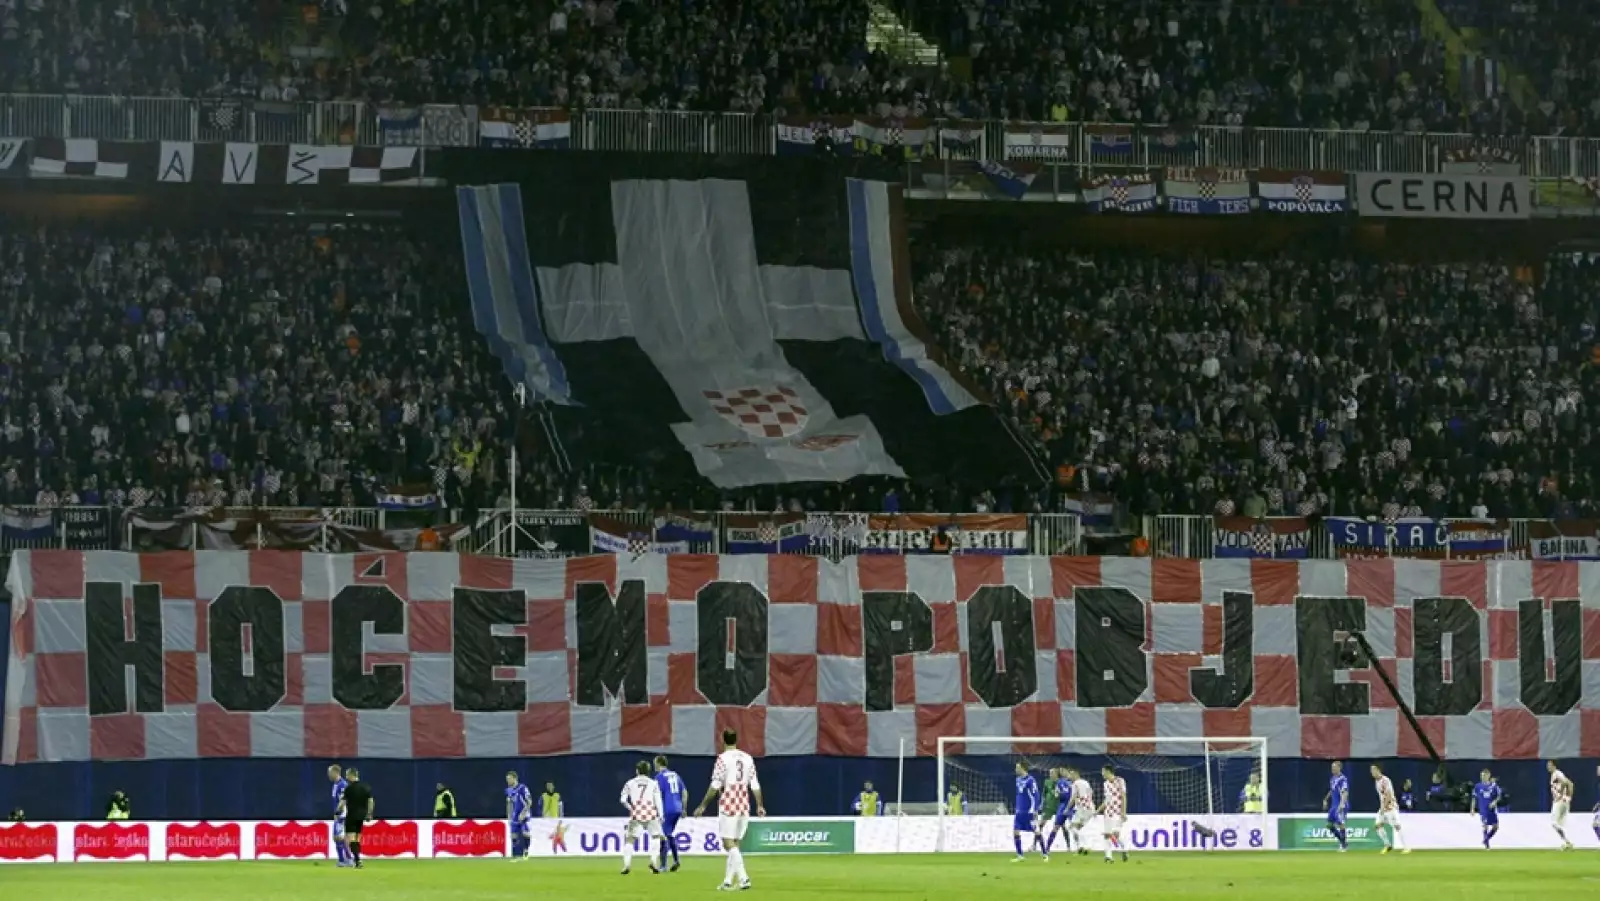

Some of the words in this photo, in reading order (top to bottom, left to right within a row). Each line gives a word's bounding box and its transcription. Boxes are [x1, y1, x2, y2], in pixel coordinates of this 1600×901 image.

[1006, 145, 1069, 159] KOMARNA
[1371, 179, 1518, 213] CERNA
[1268, 200, 1343, 213] POPOVAČA
[86, 556, 769, 715] HOĆEMO
[861, 584, 1581, 715] POBJEDU
[735, 760, 744, 781] 3
[637, 784, 648, 800] 7
[701, 833, 721, 852] &
[1249, 828, 1263, 847] &
